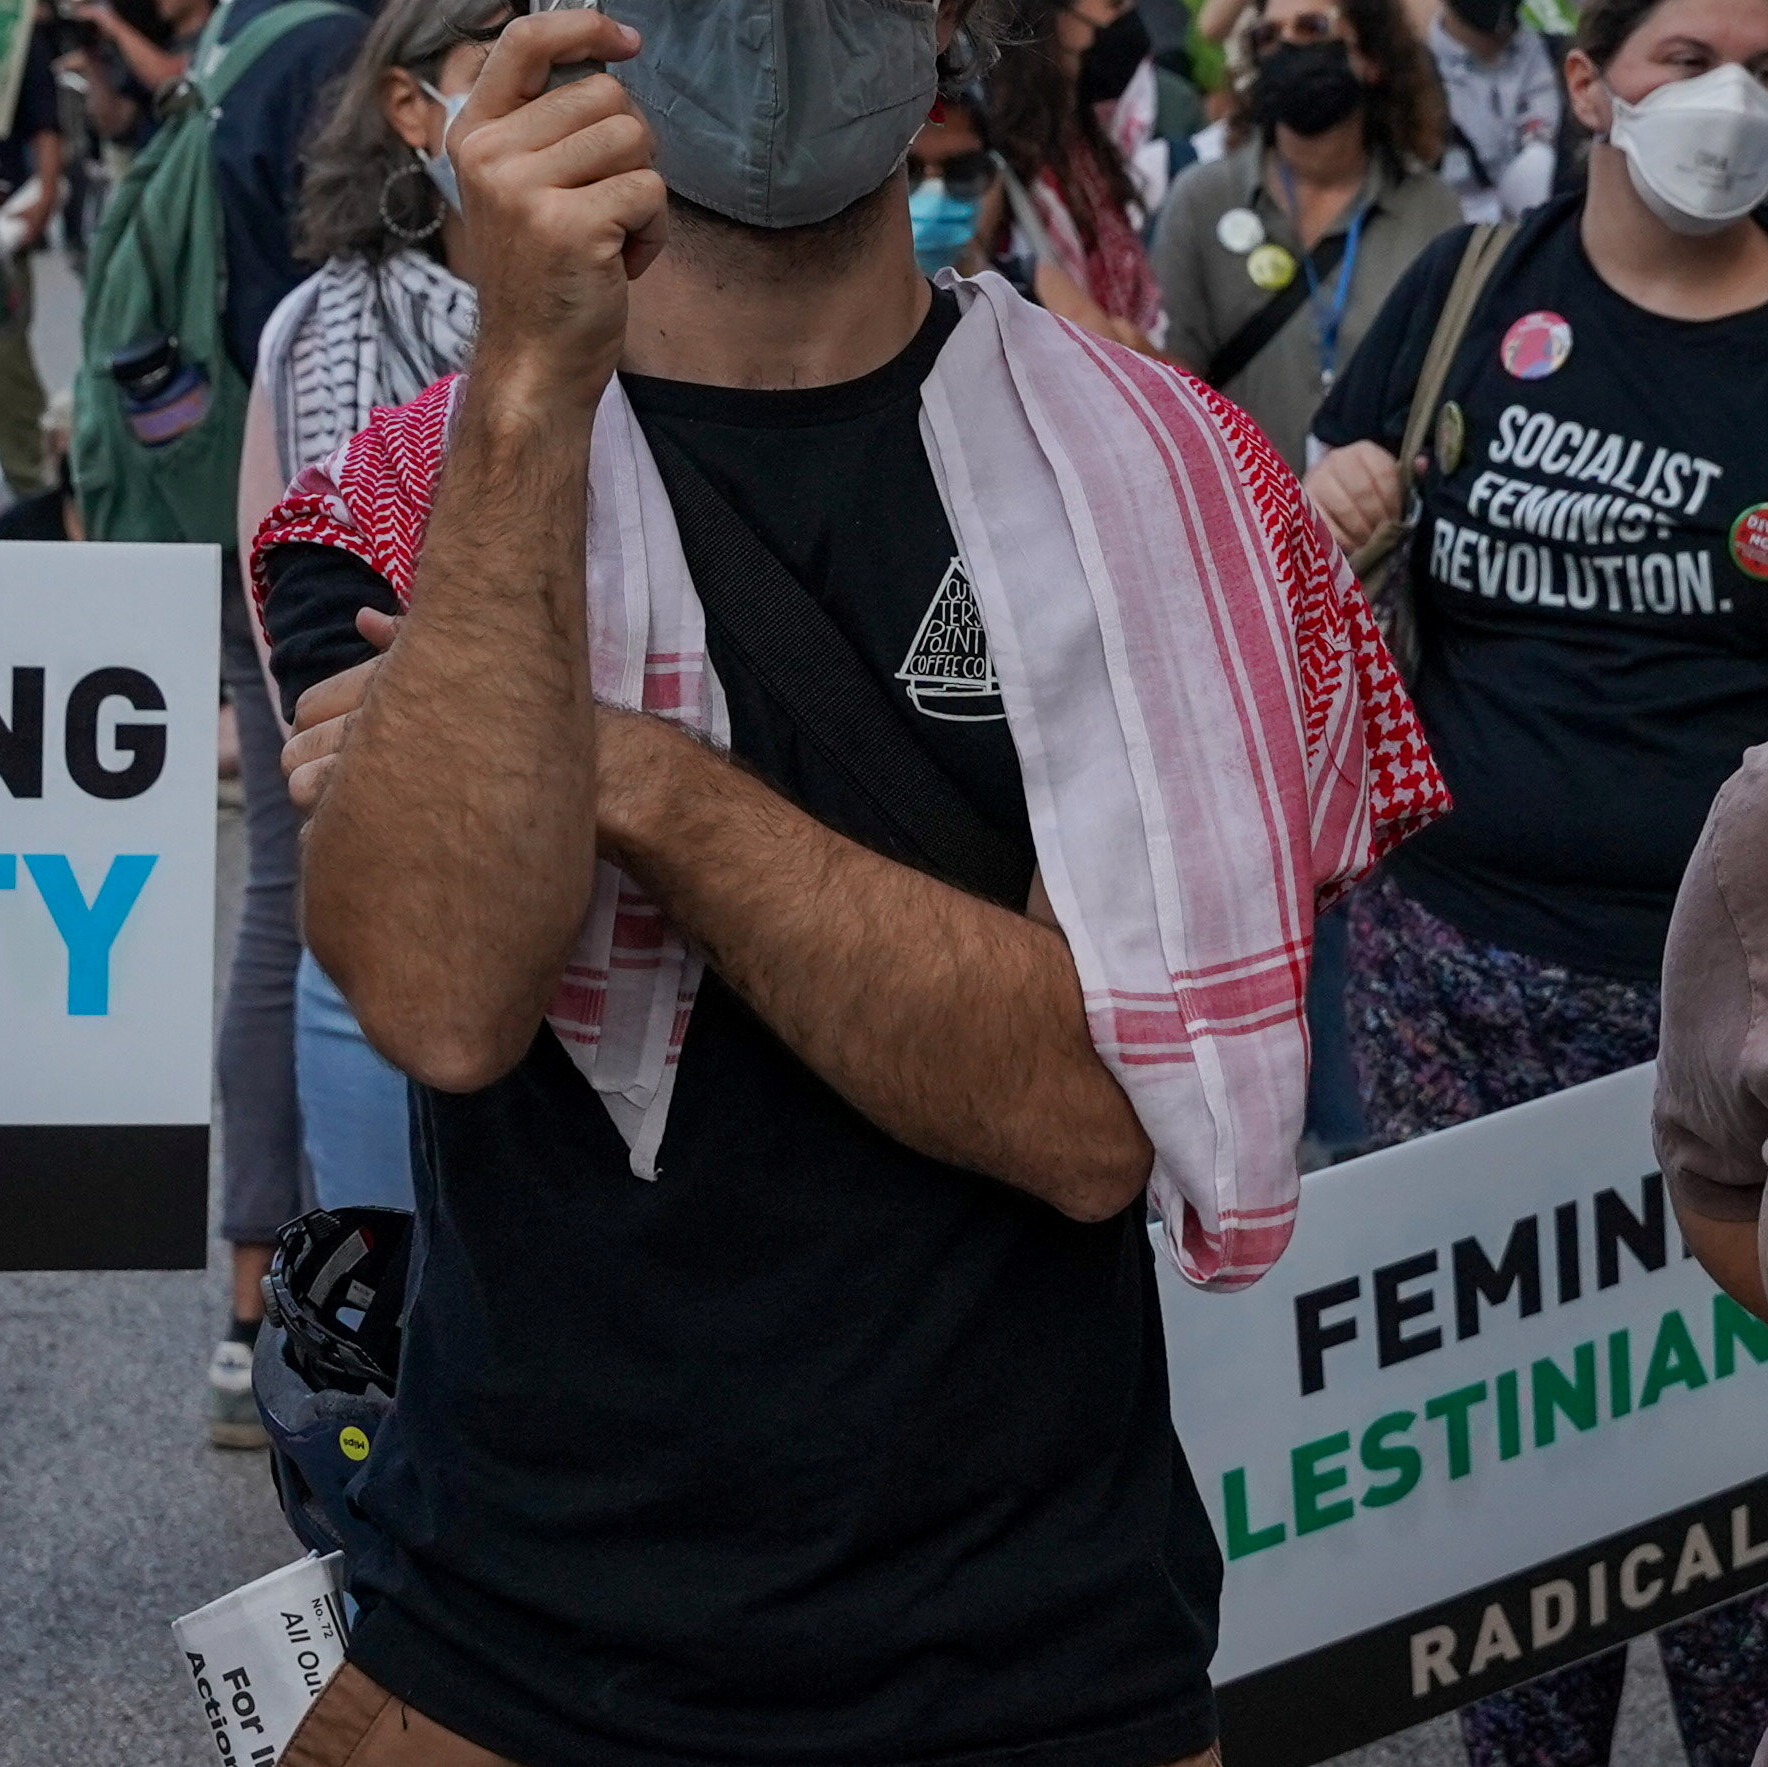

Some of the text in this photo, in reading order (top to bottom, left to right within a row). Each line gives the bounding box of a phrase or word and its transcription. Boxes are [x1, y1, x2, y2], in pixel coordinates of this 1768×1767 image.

[1487, 403, 1725, 516] SOCIALIST
[1466, 469, 1681, 546] FEMINIST
[1432, 516, 1733, 615] REVOLUTION.
[910, 654, 962, 677] COFFEE
[1293, 1170, 1697, 1397] FEMIN
[280, 1611, 312, 1644] All
[312, 1597, 334, 1639] No. 72
[222, 1666, 265, 1735] For
